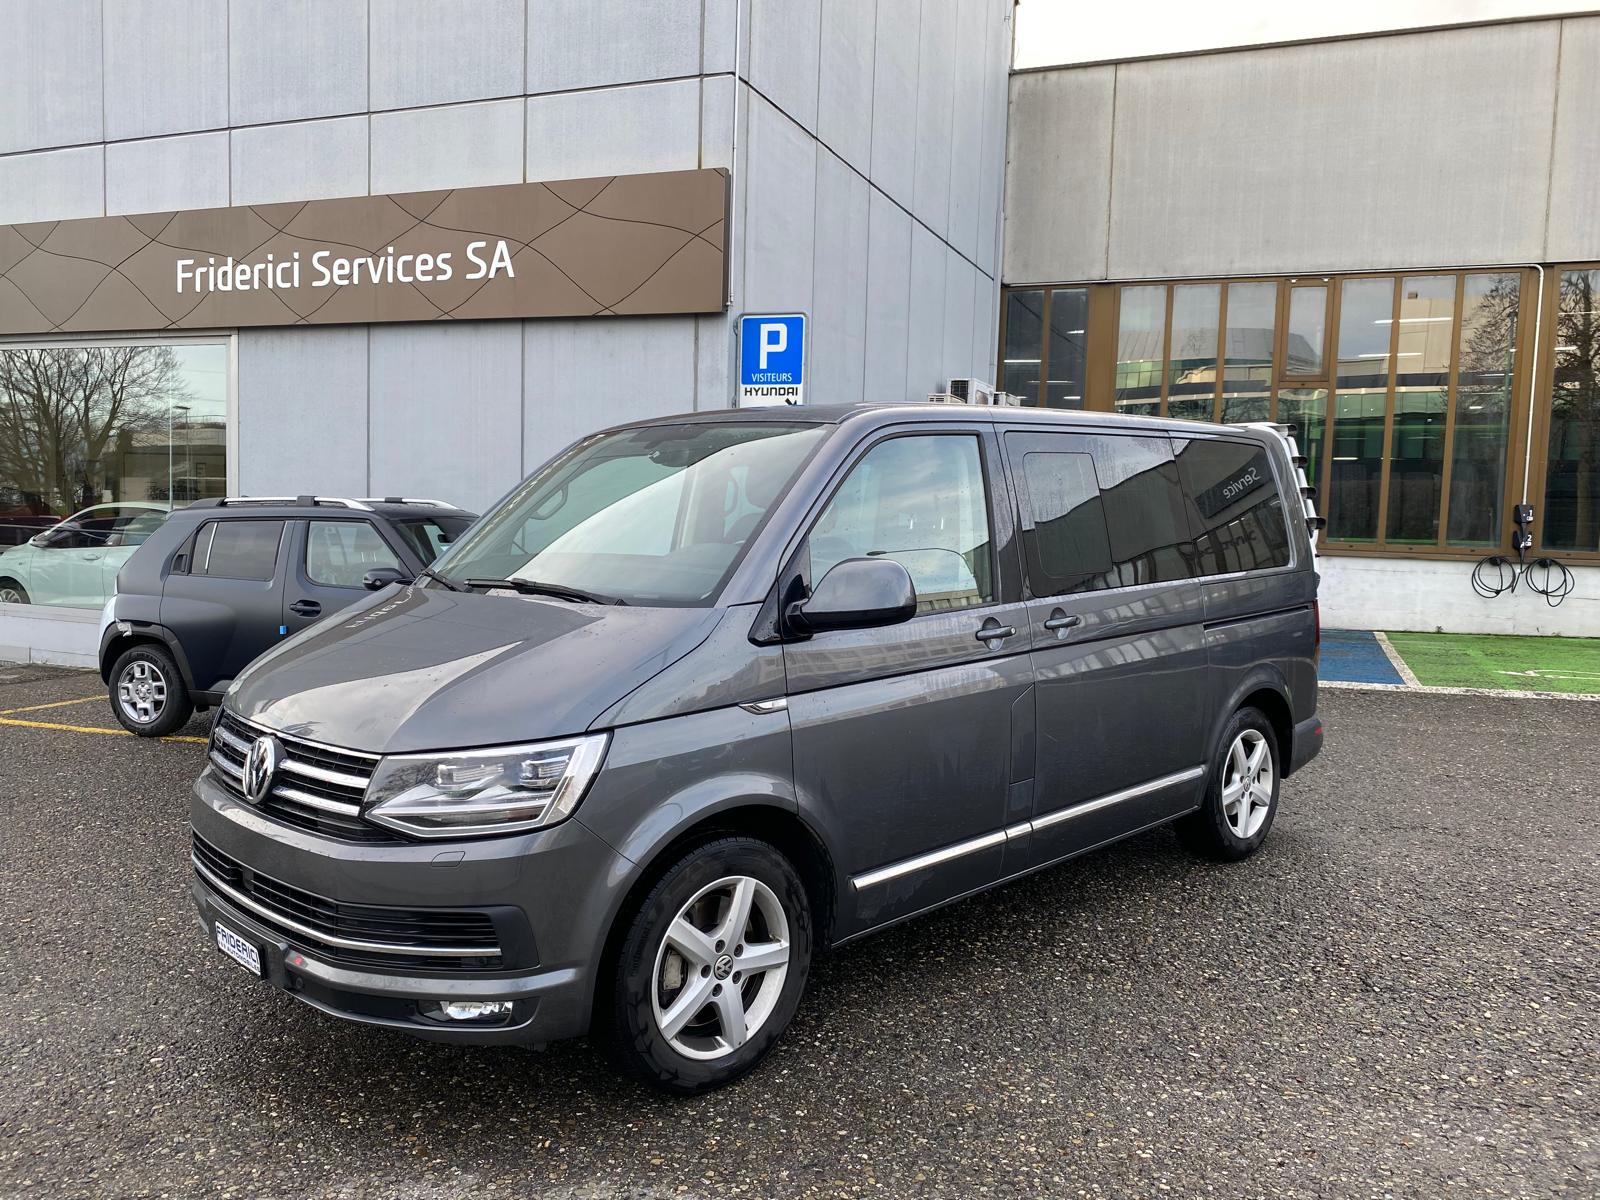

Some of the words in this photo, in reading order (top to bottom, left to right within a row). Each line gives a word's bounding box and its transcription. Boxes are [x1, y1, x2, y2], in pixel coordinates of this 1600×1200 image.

[176, 251, 299, 294] Friderici
[312, 246, 453, 287] Services
[465, 240, 515, 280] SA
[759, 323, 788, 370] P
[744, 386, 798, 396] HYUNDAI
[751, 372, 793, 382] VISITEURS
[216, 925, 260, 964] FRIDERICI
